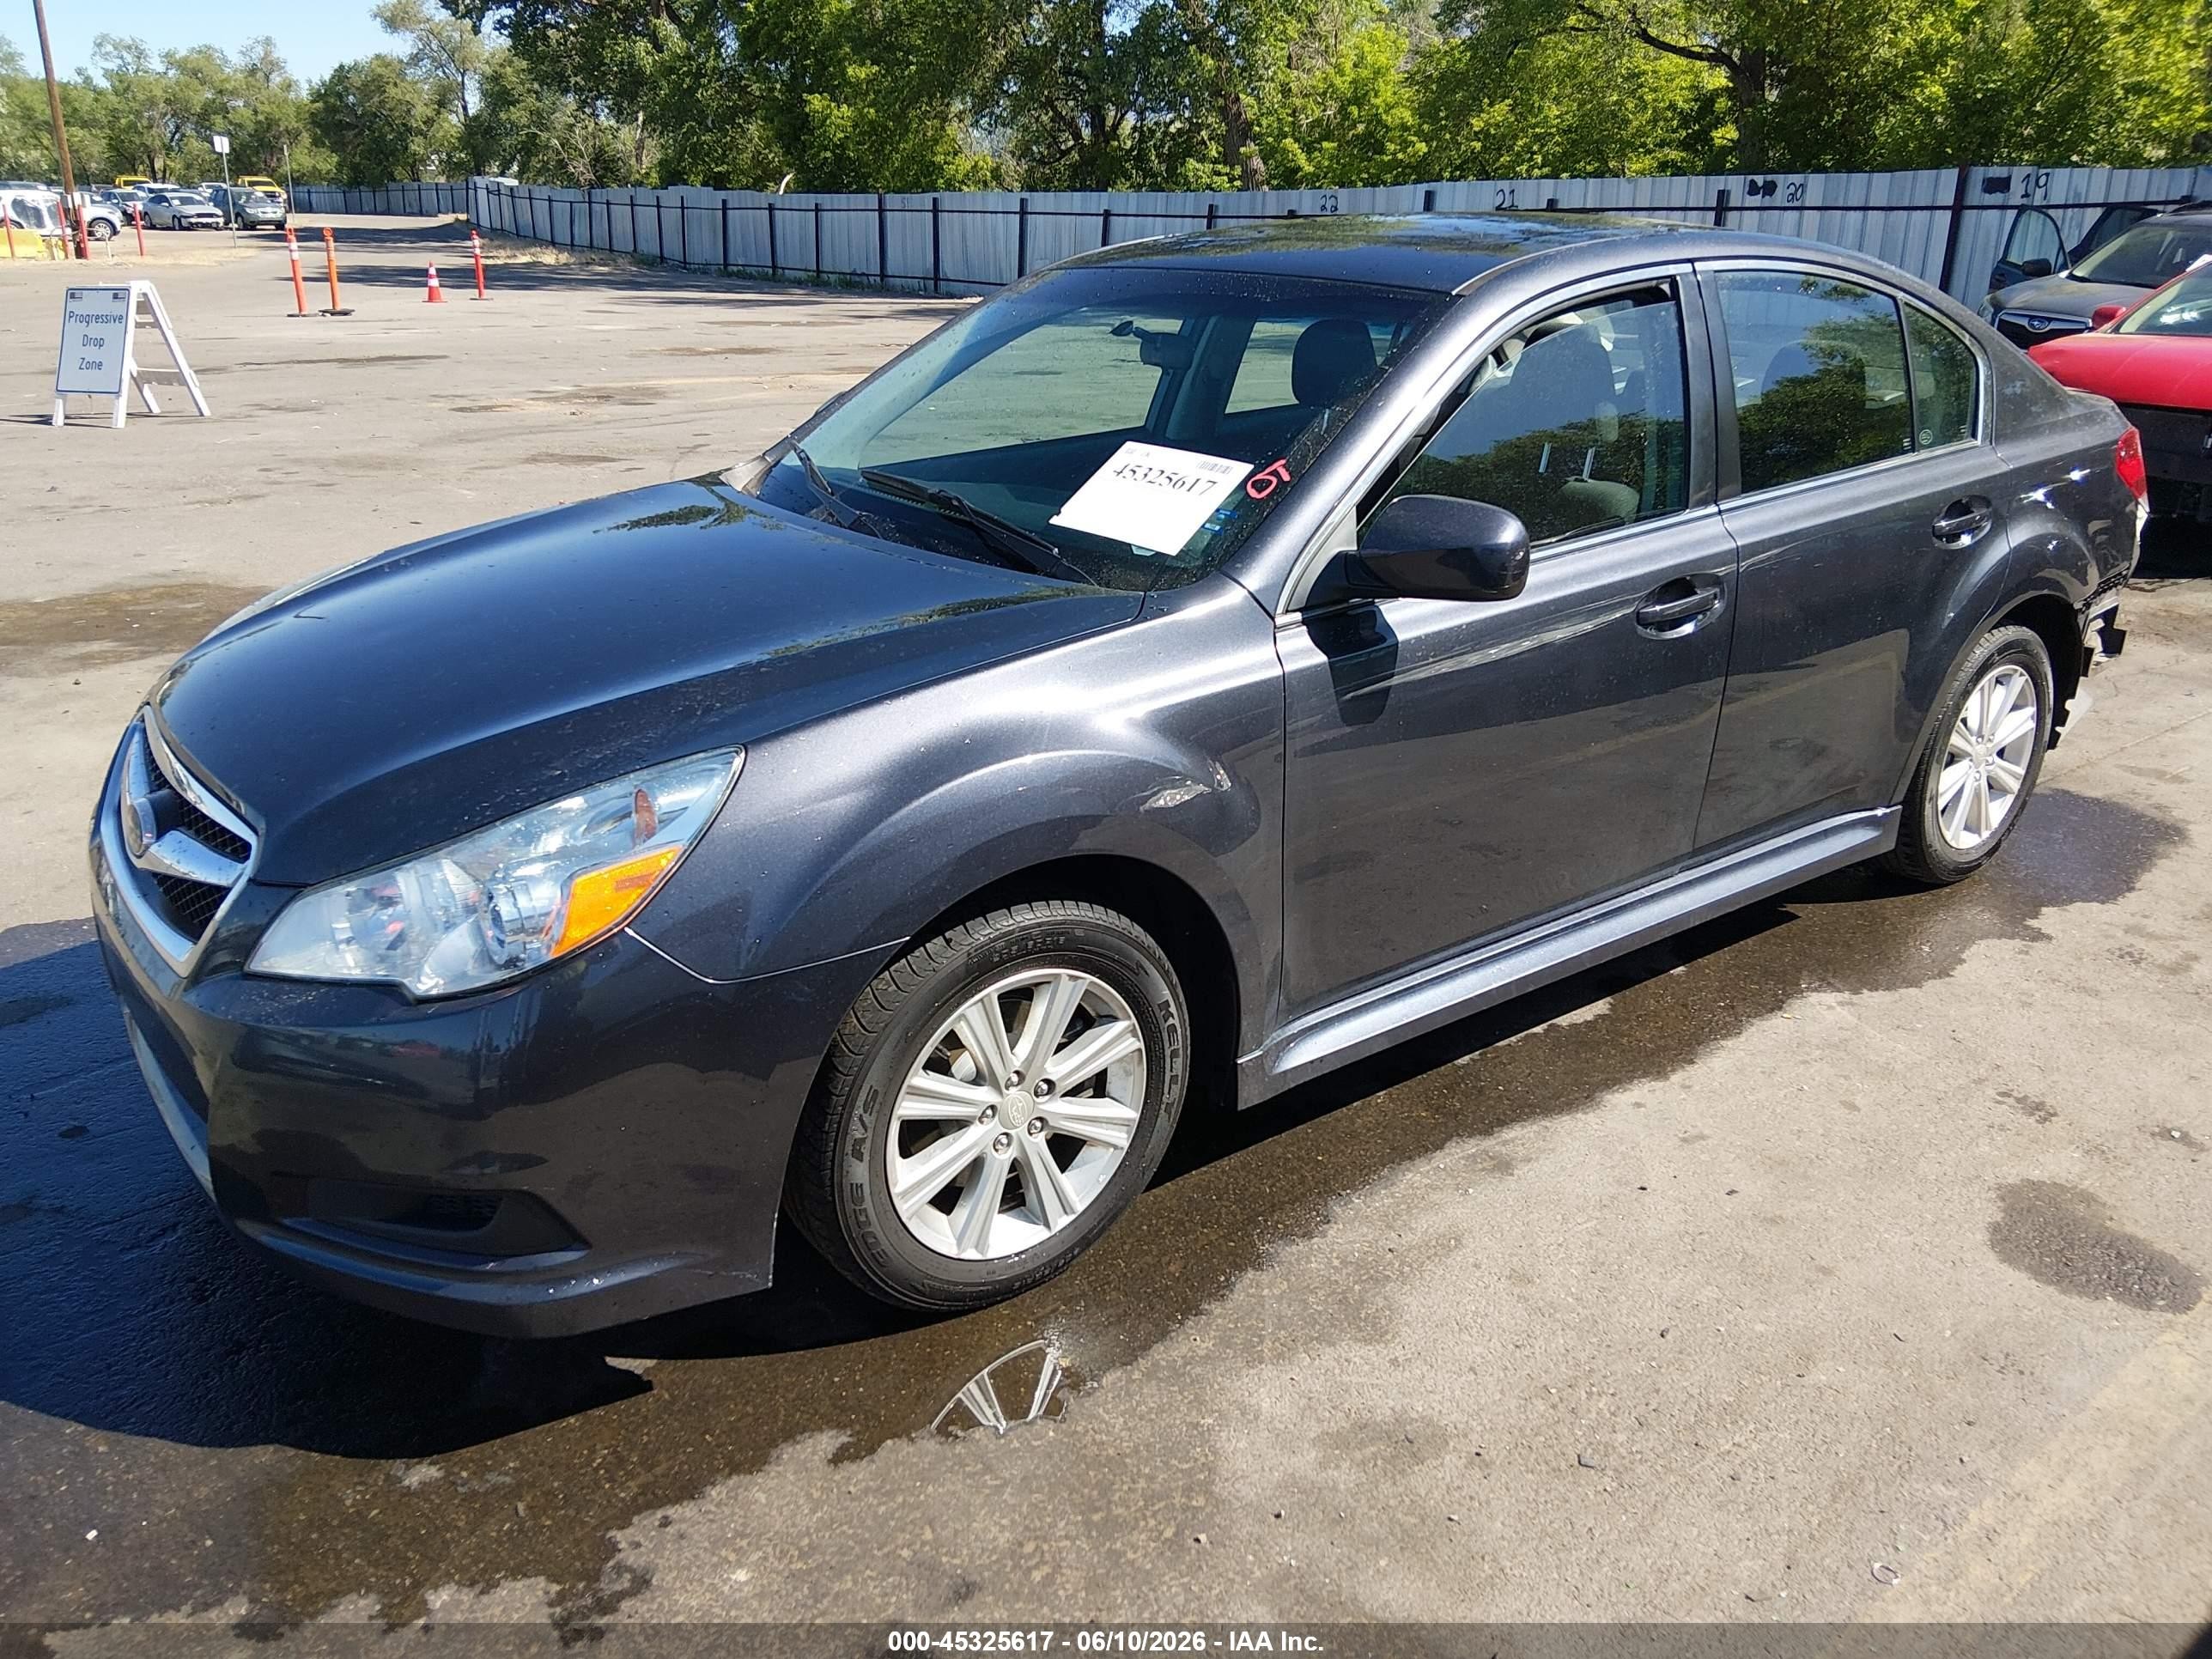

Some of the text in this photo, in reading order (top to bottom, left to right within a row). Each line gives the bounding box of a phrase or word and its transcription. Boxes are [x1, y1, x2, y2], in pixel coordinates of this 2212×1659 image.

[1786, 182, 1804, 204] 20
[2021, 173, 2050, 201] 19
[1320, 195, 1339, 214] 22
[1495, 188, 1519, 211] 21
[68, 311, 124, 327] Progressive
[82, 334, 105, 349] Drop
[79, 357, 103, 370] Zone
[1113, 463, 1218, 496] 45325617
[1157, 999, 1181, 1122] KELLY
[850, 1085, 890, 1267] EDGE A/S
